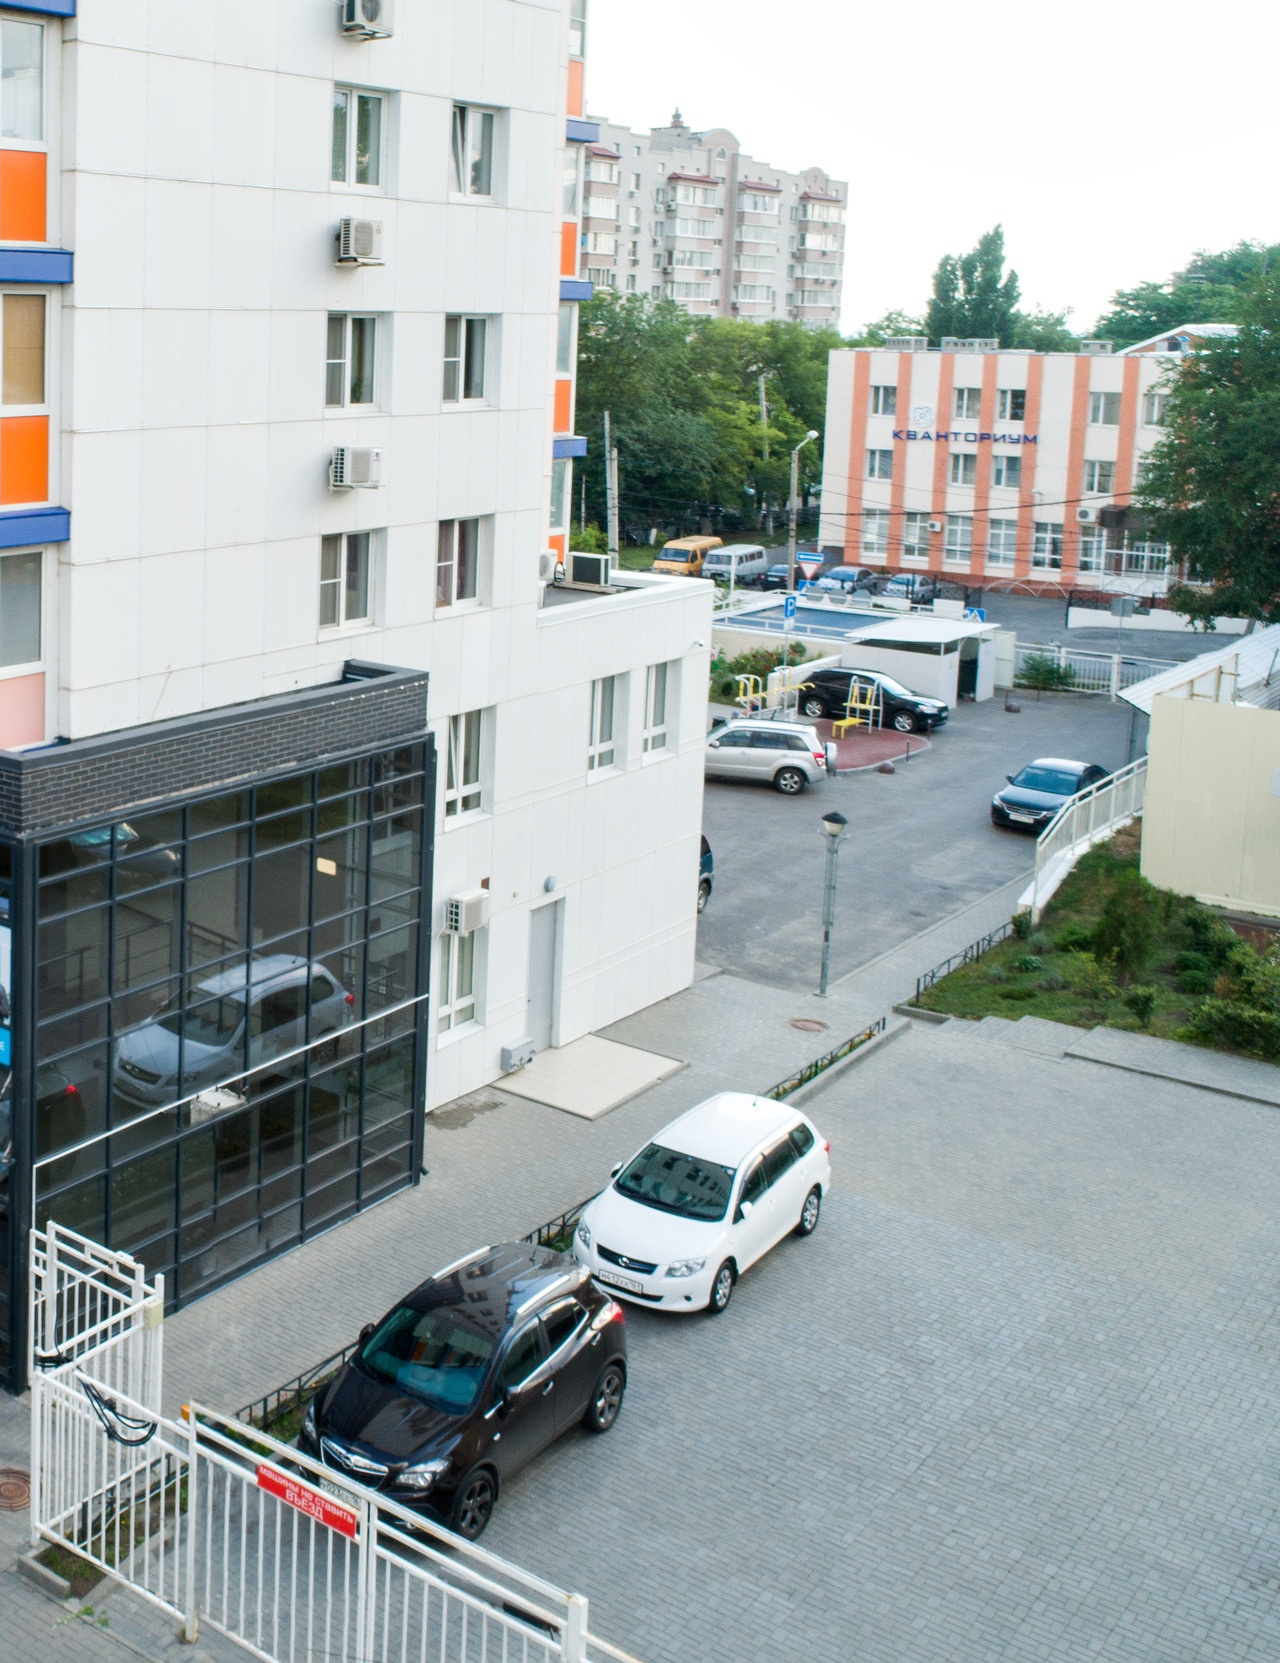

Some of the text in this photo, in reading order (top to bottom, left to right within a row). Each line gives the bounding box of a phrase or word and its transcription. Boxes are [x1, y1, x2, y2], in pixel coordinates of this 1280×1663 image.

[893, 429, 1039, 446] КВАНТОРИУМ
[260, 1467, 299, 1493] машины
[301, 1489, 313, 1501] не
[315, 1498, 354, 1524] ставить
[285, 1490, 324, 1521] ВЪЕЗД
